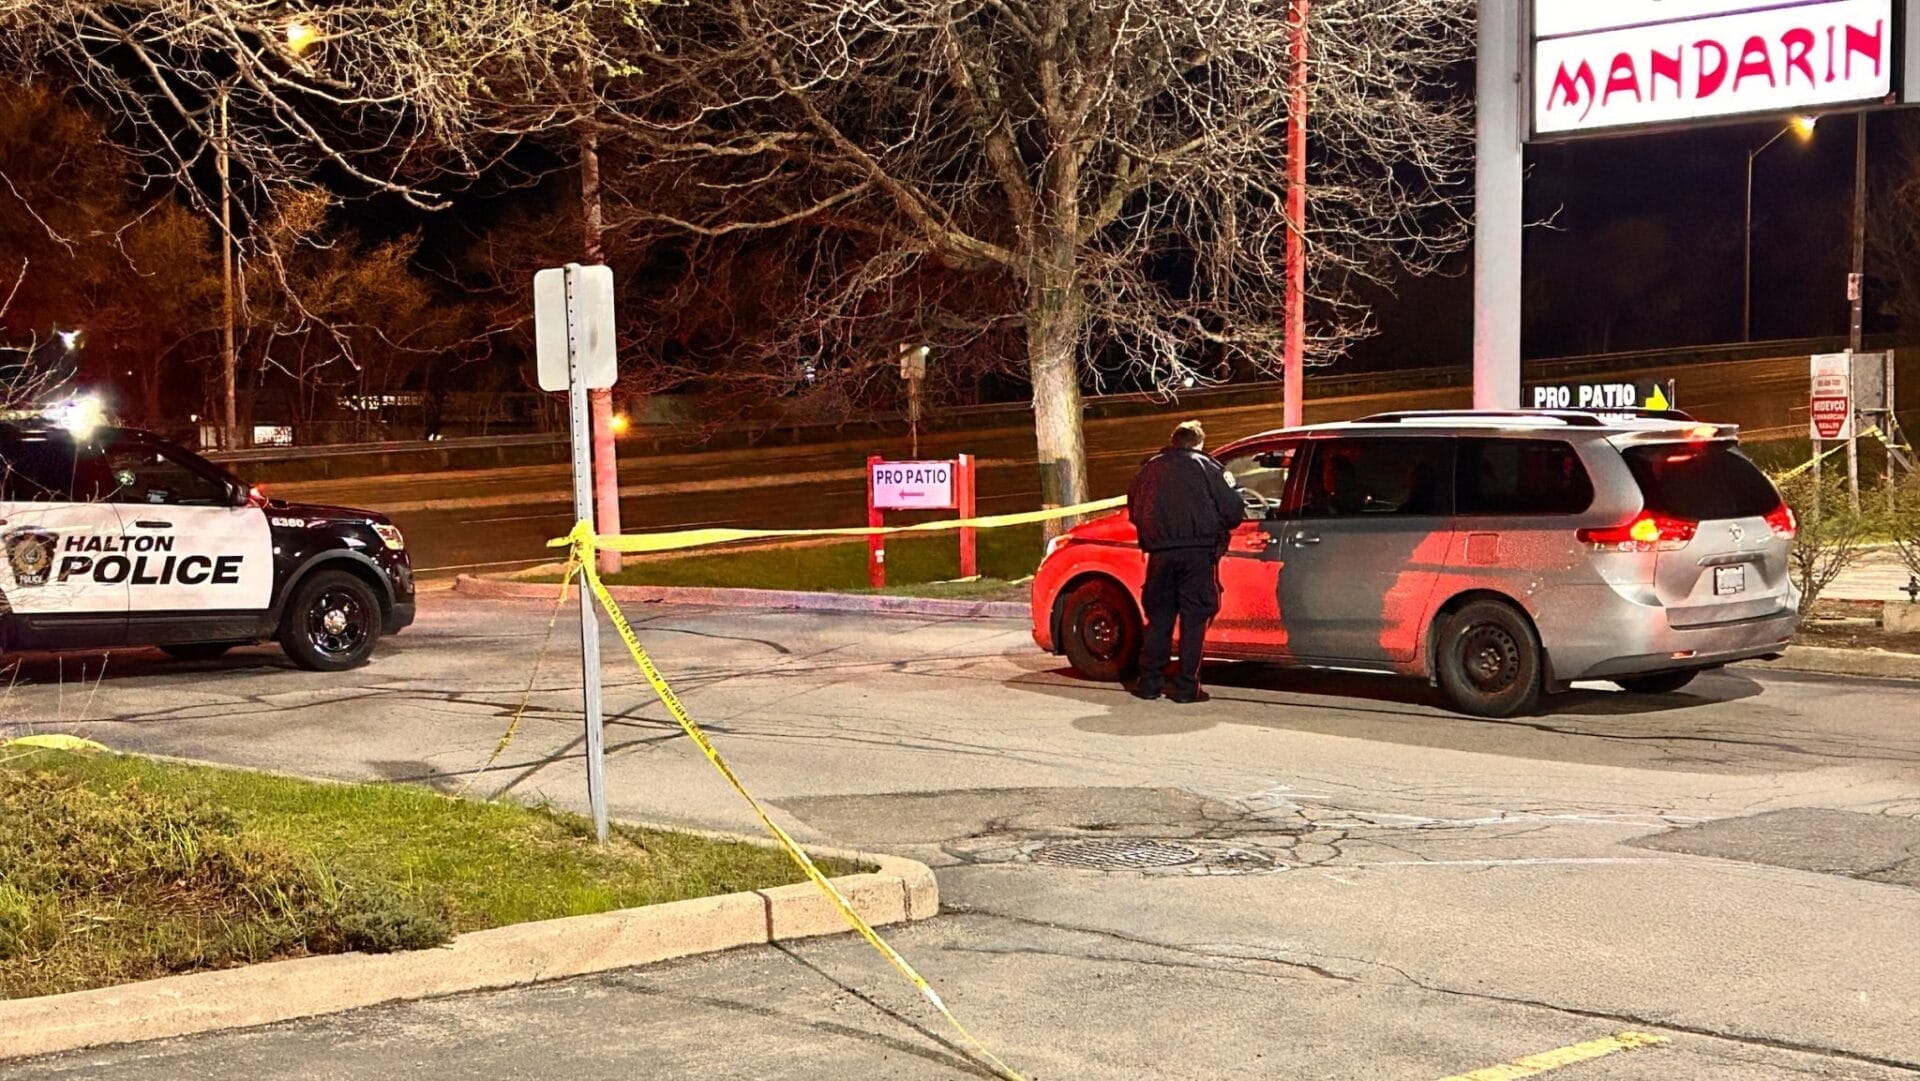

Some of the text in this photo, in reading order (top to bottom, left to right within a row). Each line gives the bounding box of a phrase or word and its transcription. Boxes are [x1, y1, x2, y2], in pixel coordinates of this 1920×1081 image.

[1546, 18, 1884, 123] MANDARIN
[1534, 384, 1636, 409] PRO PATIO
[876, 469, 947, 485] PRO PATIO
[64, 535, 175, 552] HALTON
[57, 555, 244, 585] POLICE
